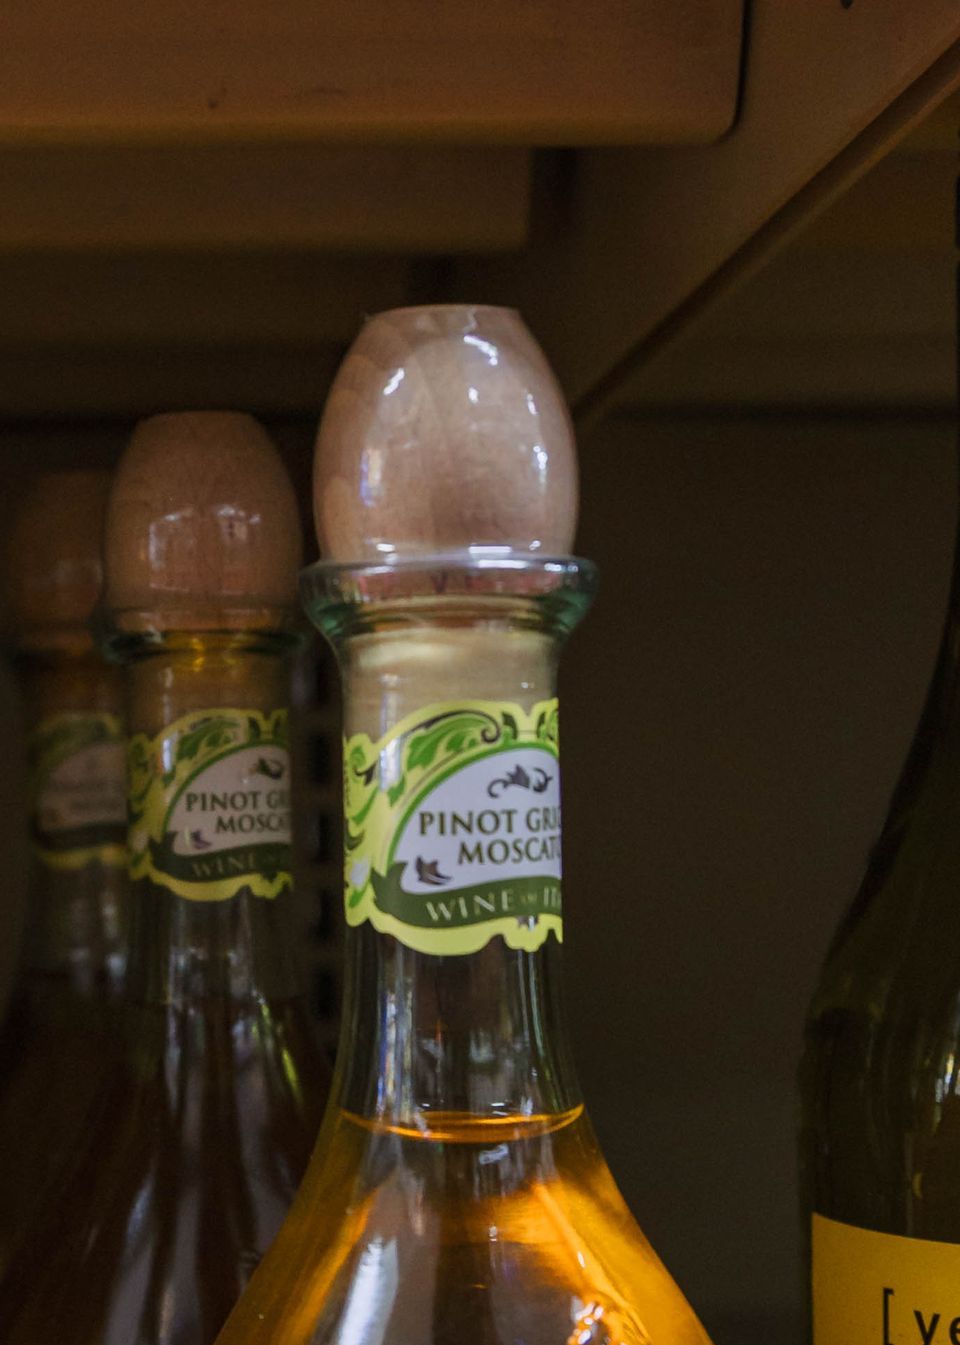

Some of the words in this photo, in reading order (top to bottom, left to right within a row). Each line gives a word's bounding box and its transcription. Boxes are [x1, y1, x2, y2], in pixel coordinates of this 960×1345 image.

[185, 790, 262, 813] PINOT
[418, 808, 518, 838] PINOT
[425, 888, 511, 922] WINE
